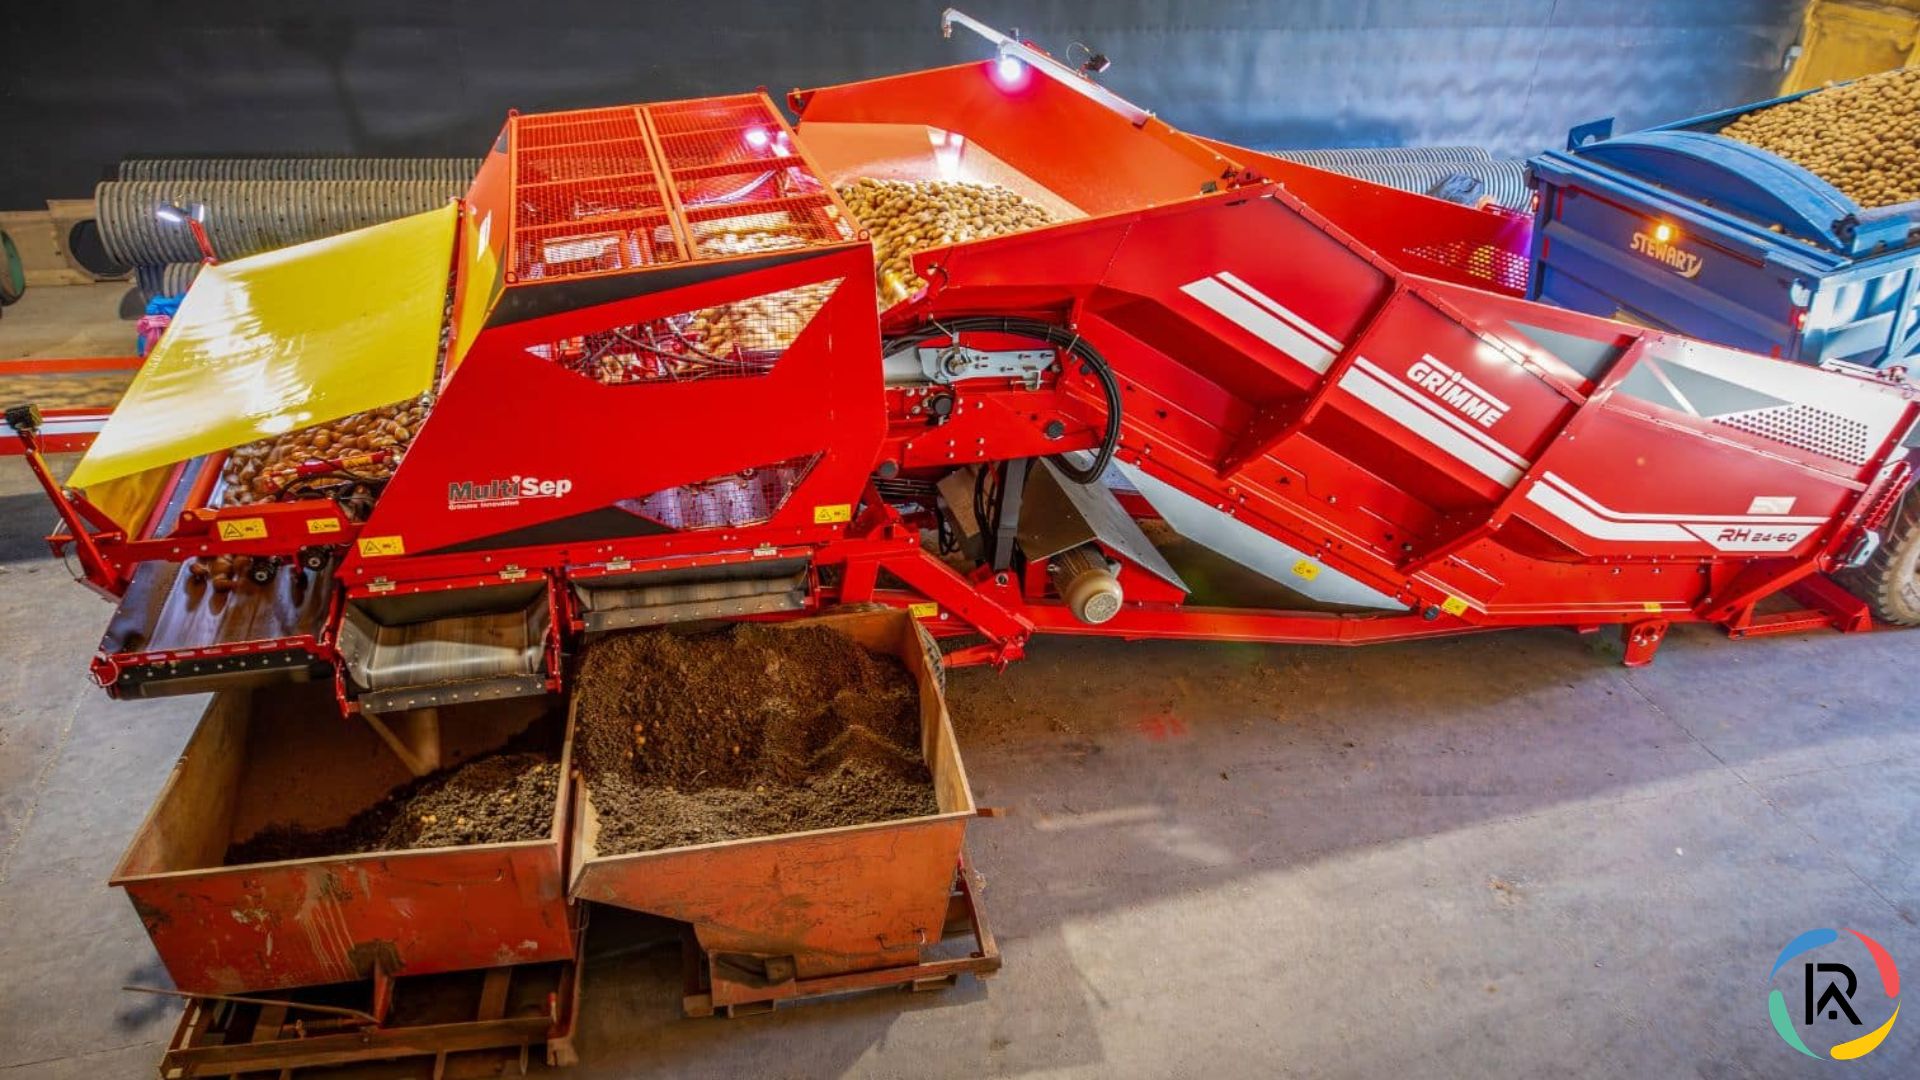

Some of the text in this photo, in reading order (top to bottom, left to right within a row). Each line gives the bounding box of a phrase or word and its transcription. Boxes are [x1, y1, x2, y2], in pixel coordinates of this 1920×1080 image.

[1630, 232, 1699, 276] STEWART
[1406, 360, 1505, 428] GRIMME
[1717, 528, 1797, 542] RH 24-60
